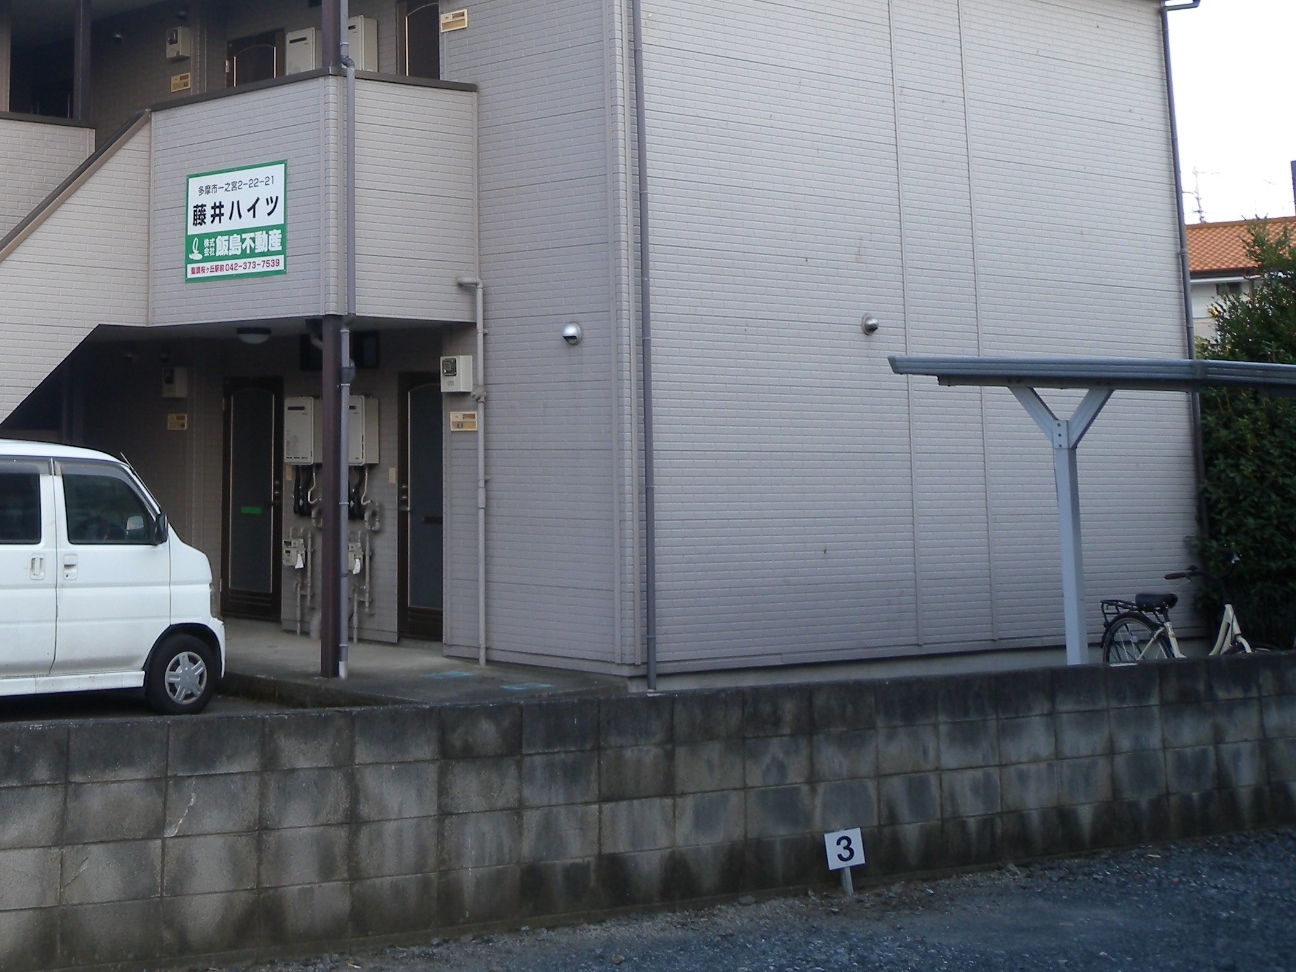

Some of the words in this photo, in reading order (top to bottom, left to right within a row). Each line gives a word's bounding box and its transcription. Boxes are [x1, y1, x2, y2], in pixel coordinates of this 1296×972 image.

[192, 195, 279, 227] 藤井ハイツ
[215, 229, 282, 257] 飯島不動産
[836, 835, 855, 862] 3
